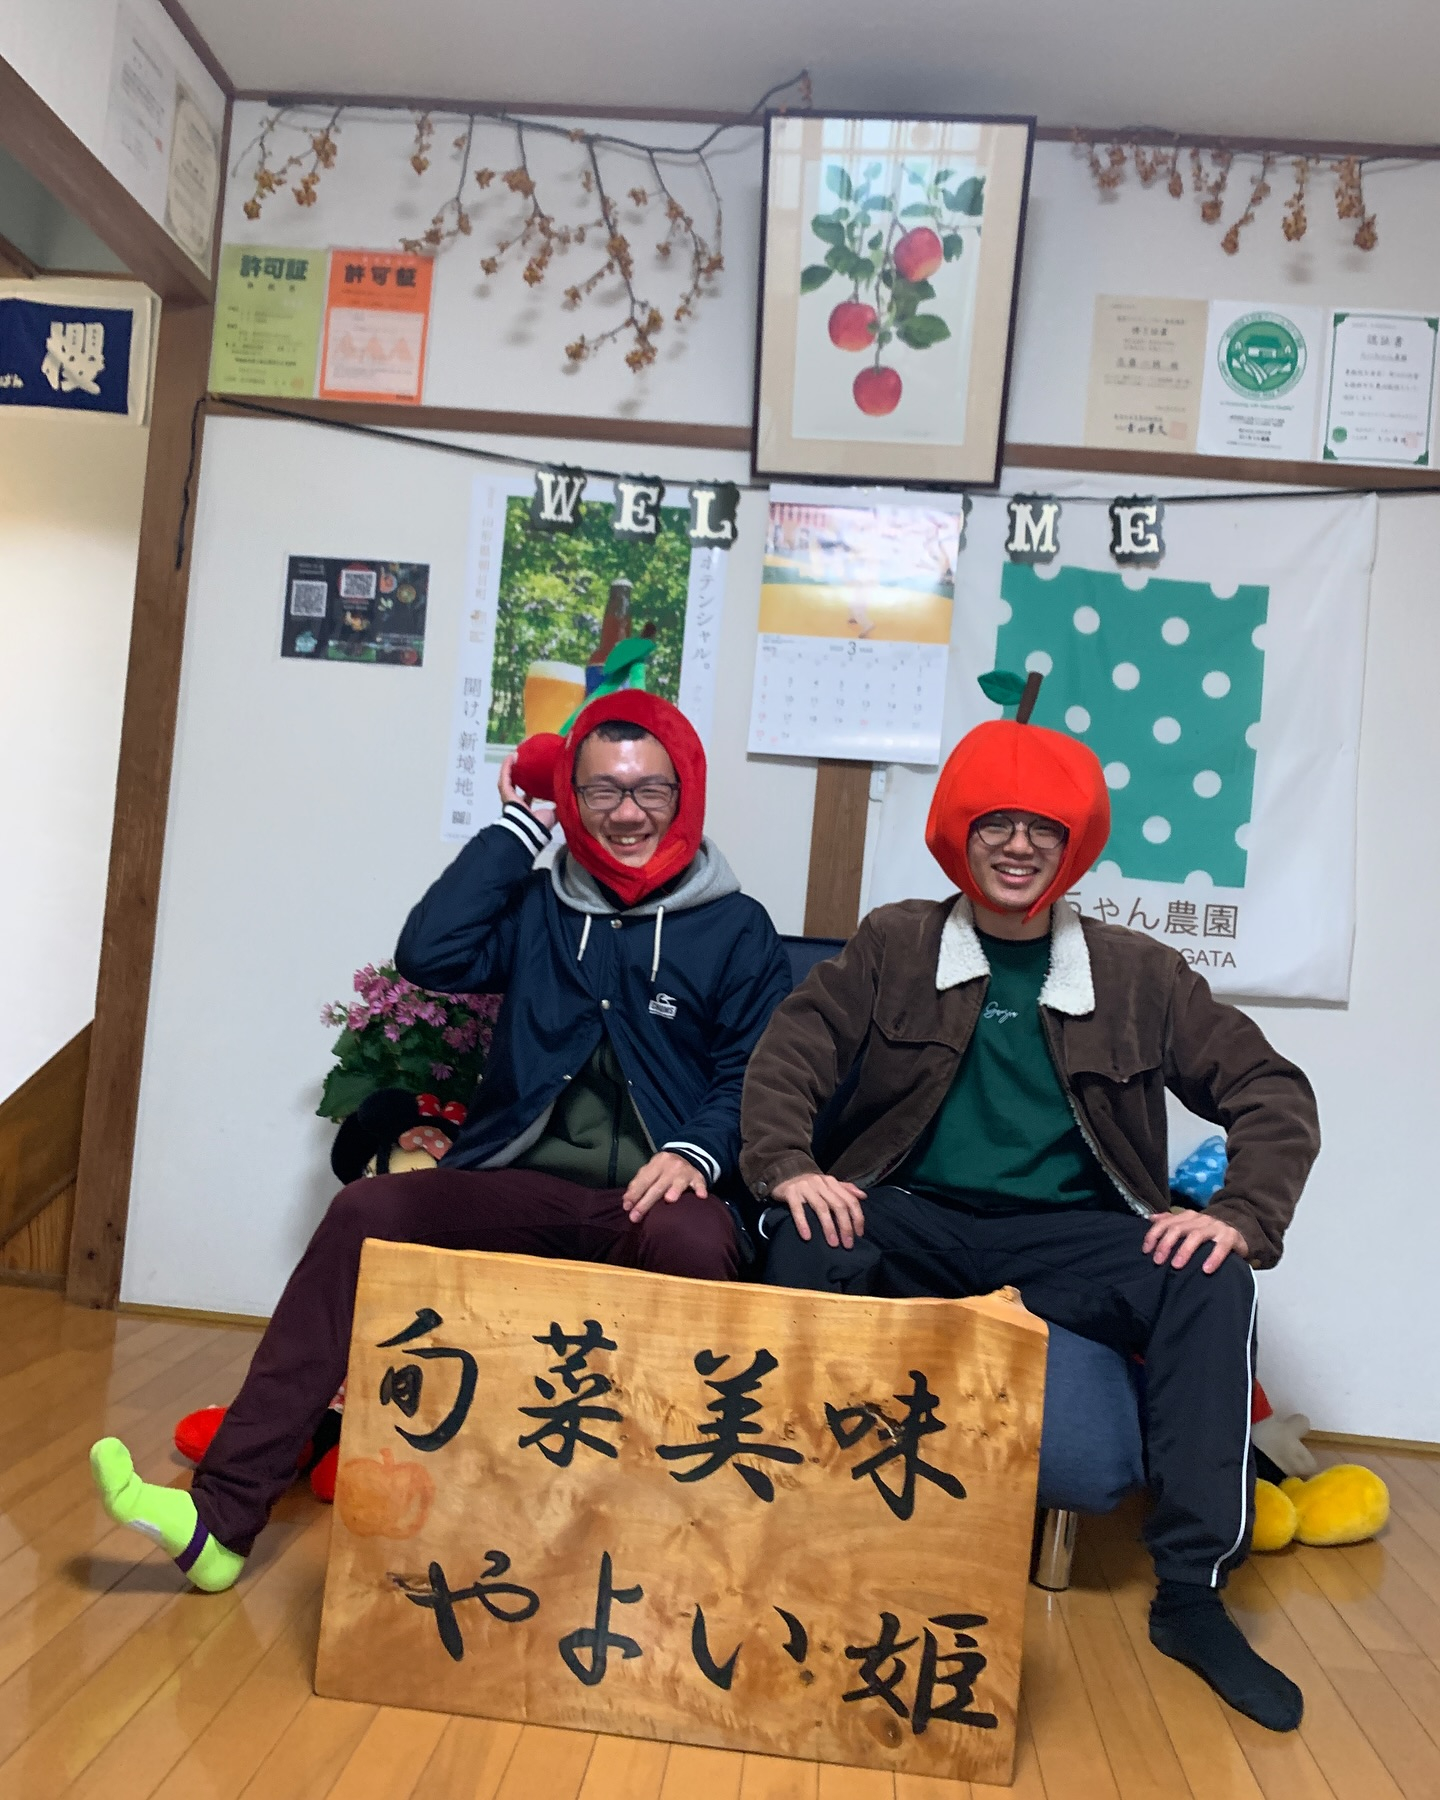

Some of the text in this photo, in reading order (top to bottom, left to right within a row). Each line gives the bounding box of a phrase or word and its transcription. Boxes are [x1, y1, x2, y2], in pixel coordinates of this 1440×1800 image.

[847, 641, 857, 656] 3
[375, 1307, 968, 1521] 旬菜美味
[395, 1550, 999, 1736] やよい姫
